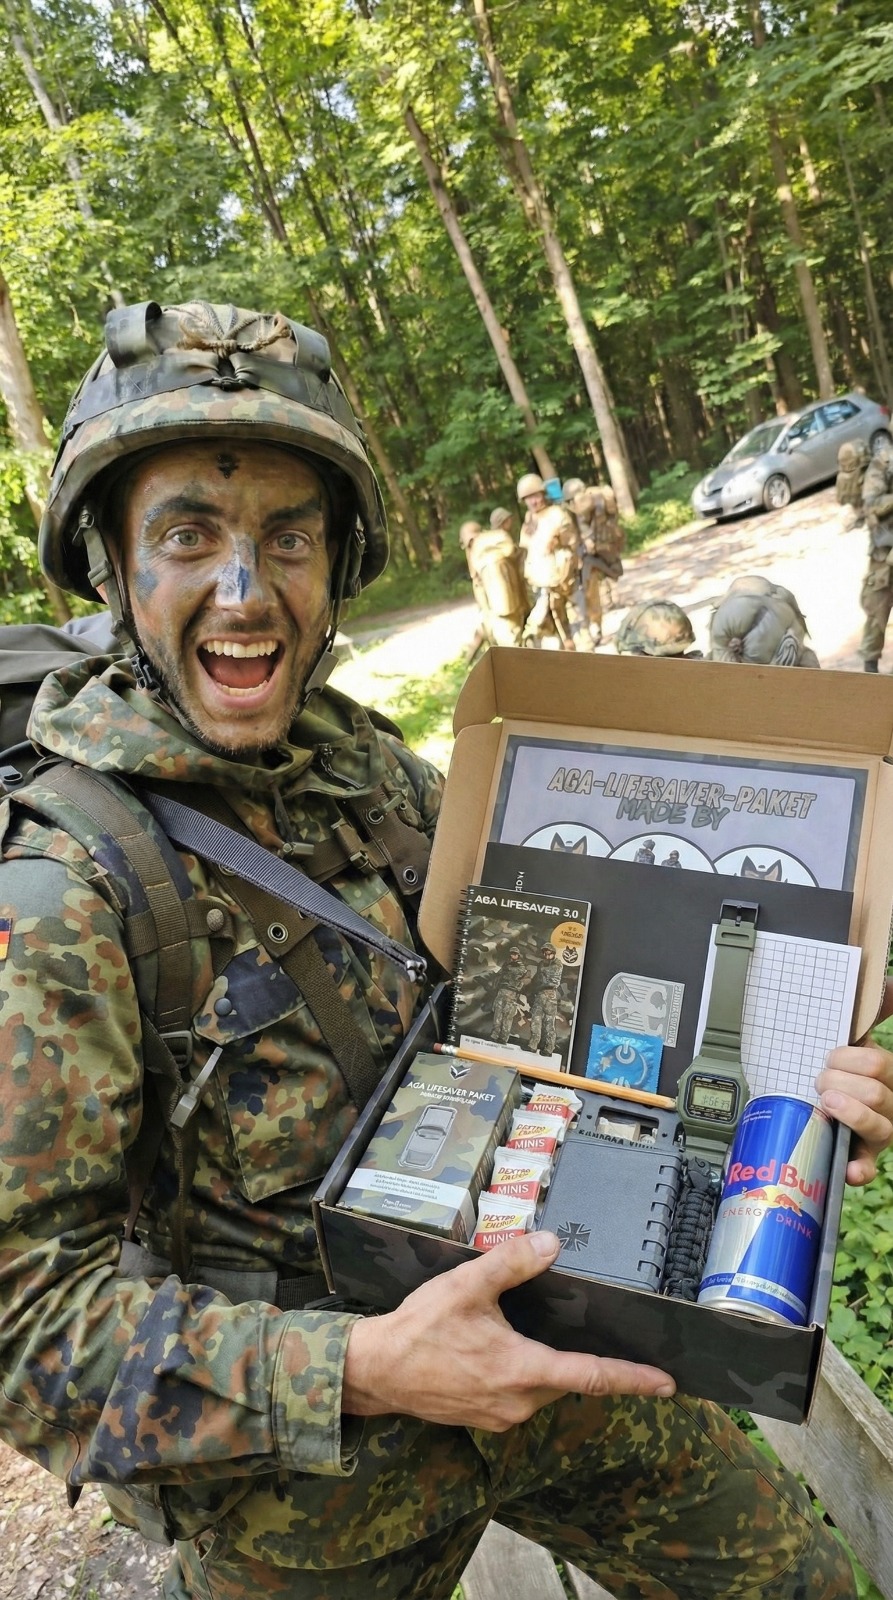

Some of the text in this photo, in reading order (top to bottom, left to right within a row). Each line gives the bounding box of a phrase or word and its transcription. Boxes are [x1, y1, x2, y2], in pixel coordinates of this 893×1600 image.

[548, 767, 817, 819] AGA-LIFESAVER-PAKET
[616, 797, 730, 831] MADE BY
[500, 898, 560, 916] LIFESAVER
[407, 1081, 425, 1090] AGA
[426, 1083, 467, 1097] LIFESAVER
[468, 1090, 496, 1102] PAKET
[532, 1103, 562, 1112] MINIS
[514, 1139, 545, 1149] MINIS
[496, 1184, 529, 1195] MINIS
[728, 1159, 826, 1206] Red Bull
[722, 1207, 813, 1239] ENERGY DRINK
